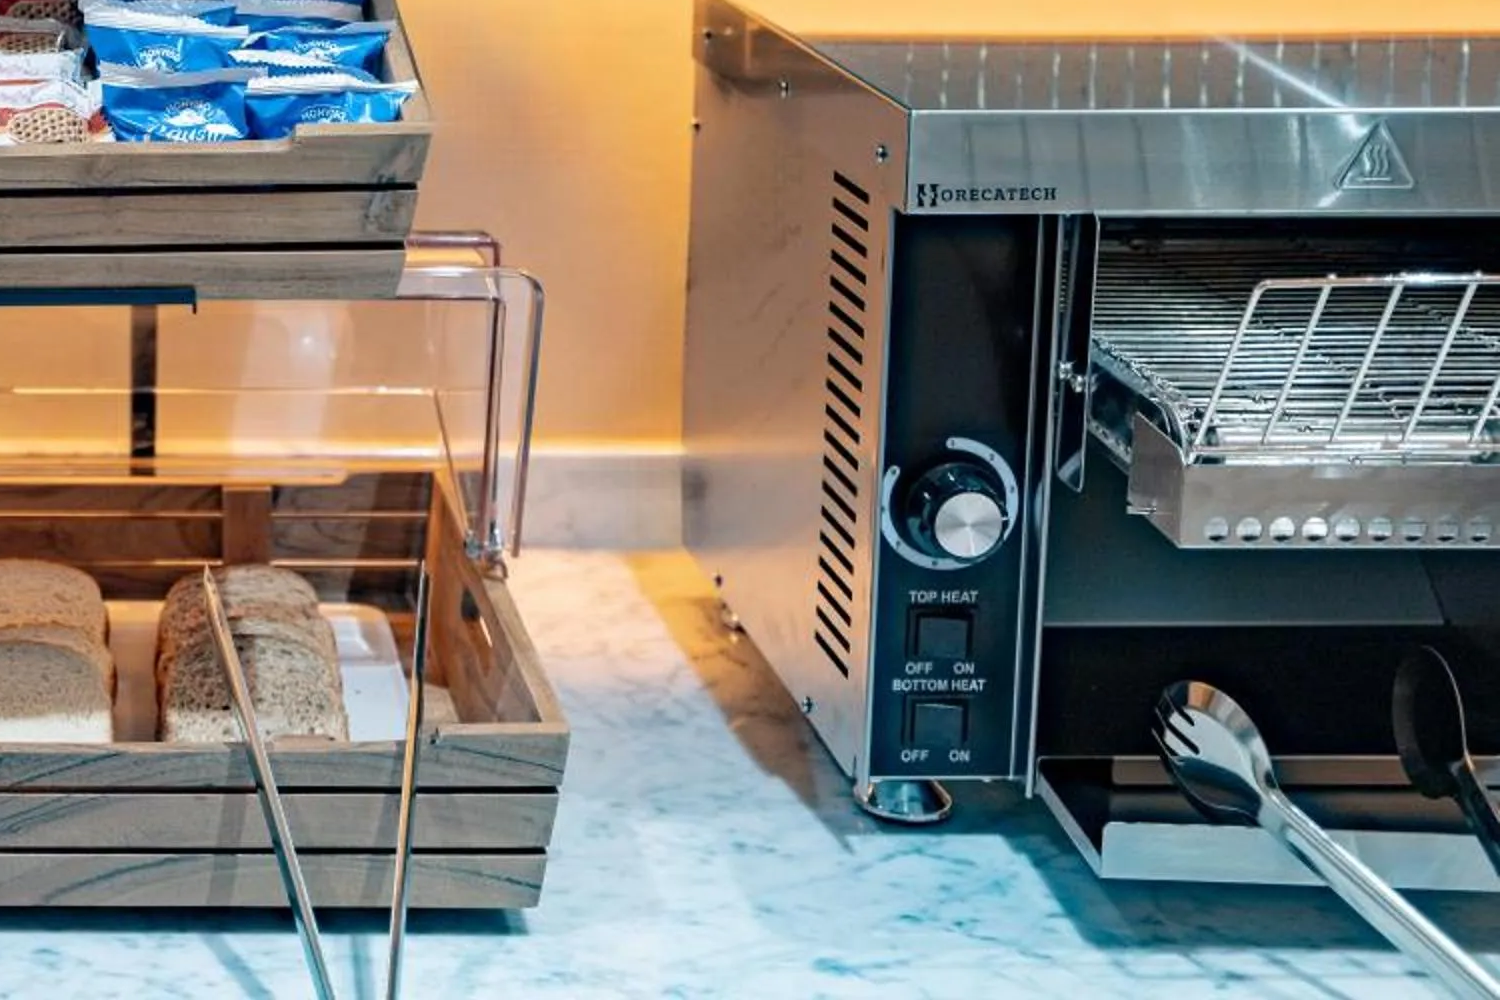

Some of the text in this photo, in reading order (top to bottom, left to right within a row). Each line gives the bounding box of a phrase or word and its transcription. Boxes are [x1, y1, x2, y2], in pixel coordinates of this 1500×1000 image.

[916, 183, 1057, 208] HORECATECH
[908, 590, 979, 604] TOP HEAT
[904, 661, 976, 675] OFF ON
[892, 678, 987, 692] BOTTOM HEAT
[900, 749, 971, 763] OFF ON
